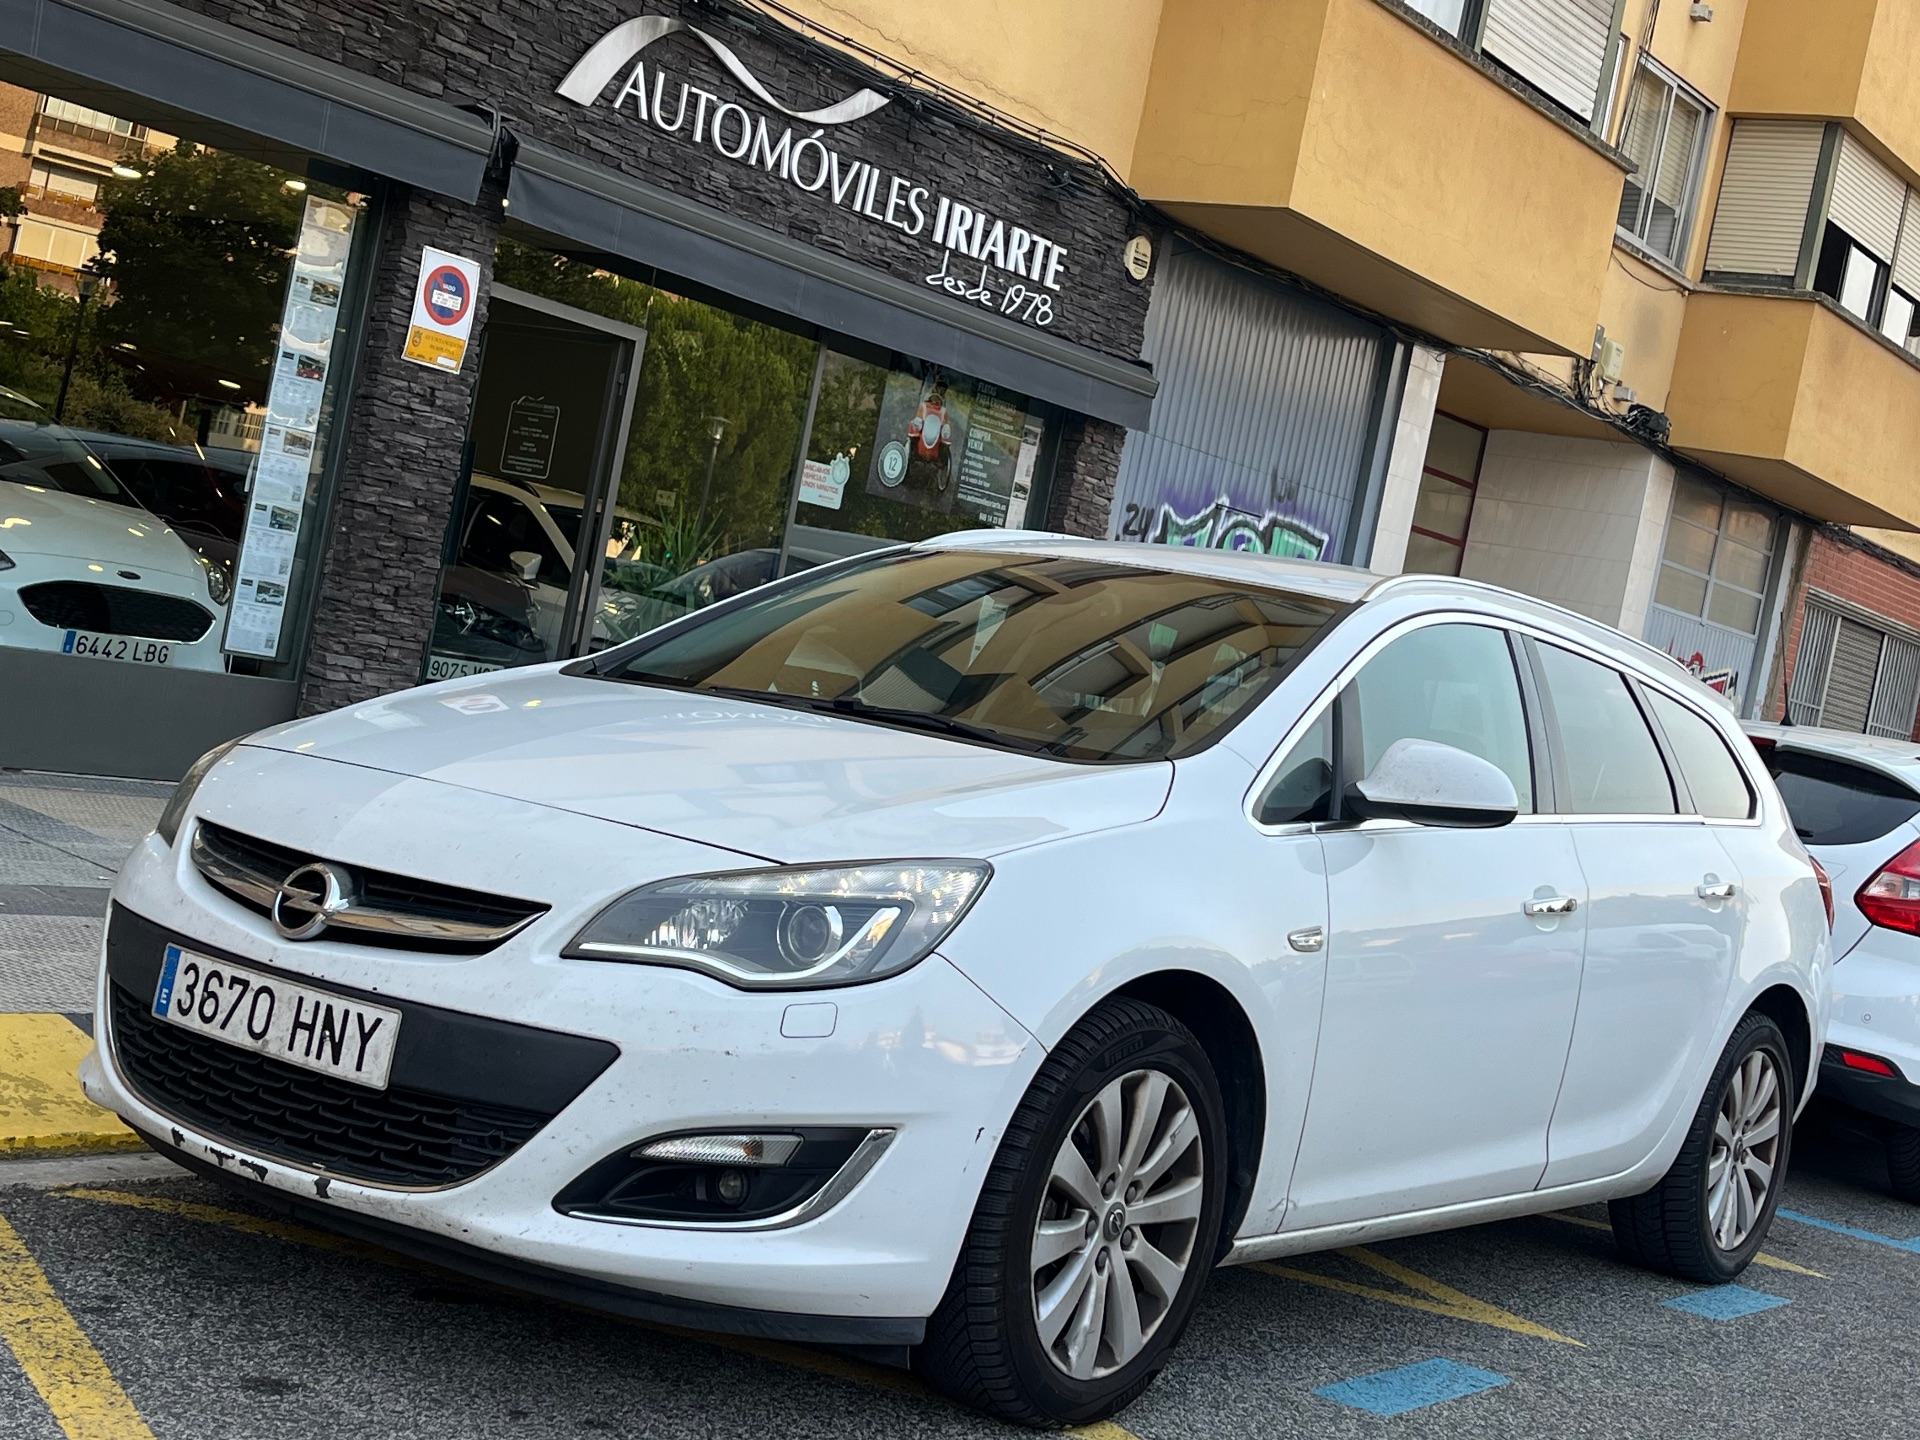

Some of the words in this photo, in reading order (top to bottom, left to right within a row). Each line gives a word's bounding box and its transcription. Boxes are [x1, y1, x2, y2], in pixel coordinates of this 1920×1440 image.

[612, 61, 930, 236] AUTOMÓVILES
[931, 197, 1068, 292] IRIARTE
[925, 249, 993, 306] desde
[1000, 284, 1053, 325] 1978
[967, 438, 984, 452] VENTA
[968, 427, 992, 442] COMPRA
[76, 635, 126, 660] 6442
[133, 642, 170, 664] LBG
[430, 660, 468, 679] 9075
[176, 962, 276, 1041] 3670
[287, 995, 383, 1073] HNY
